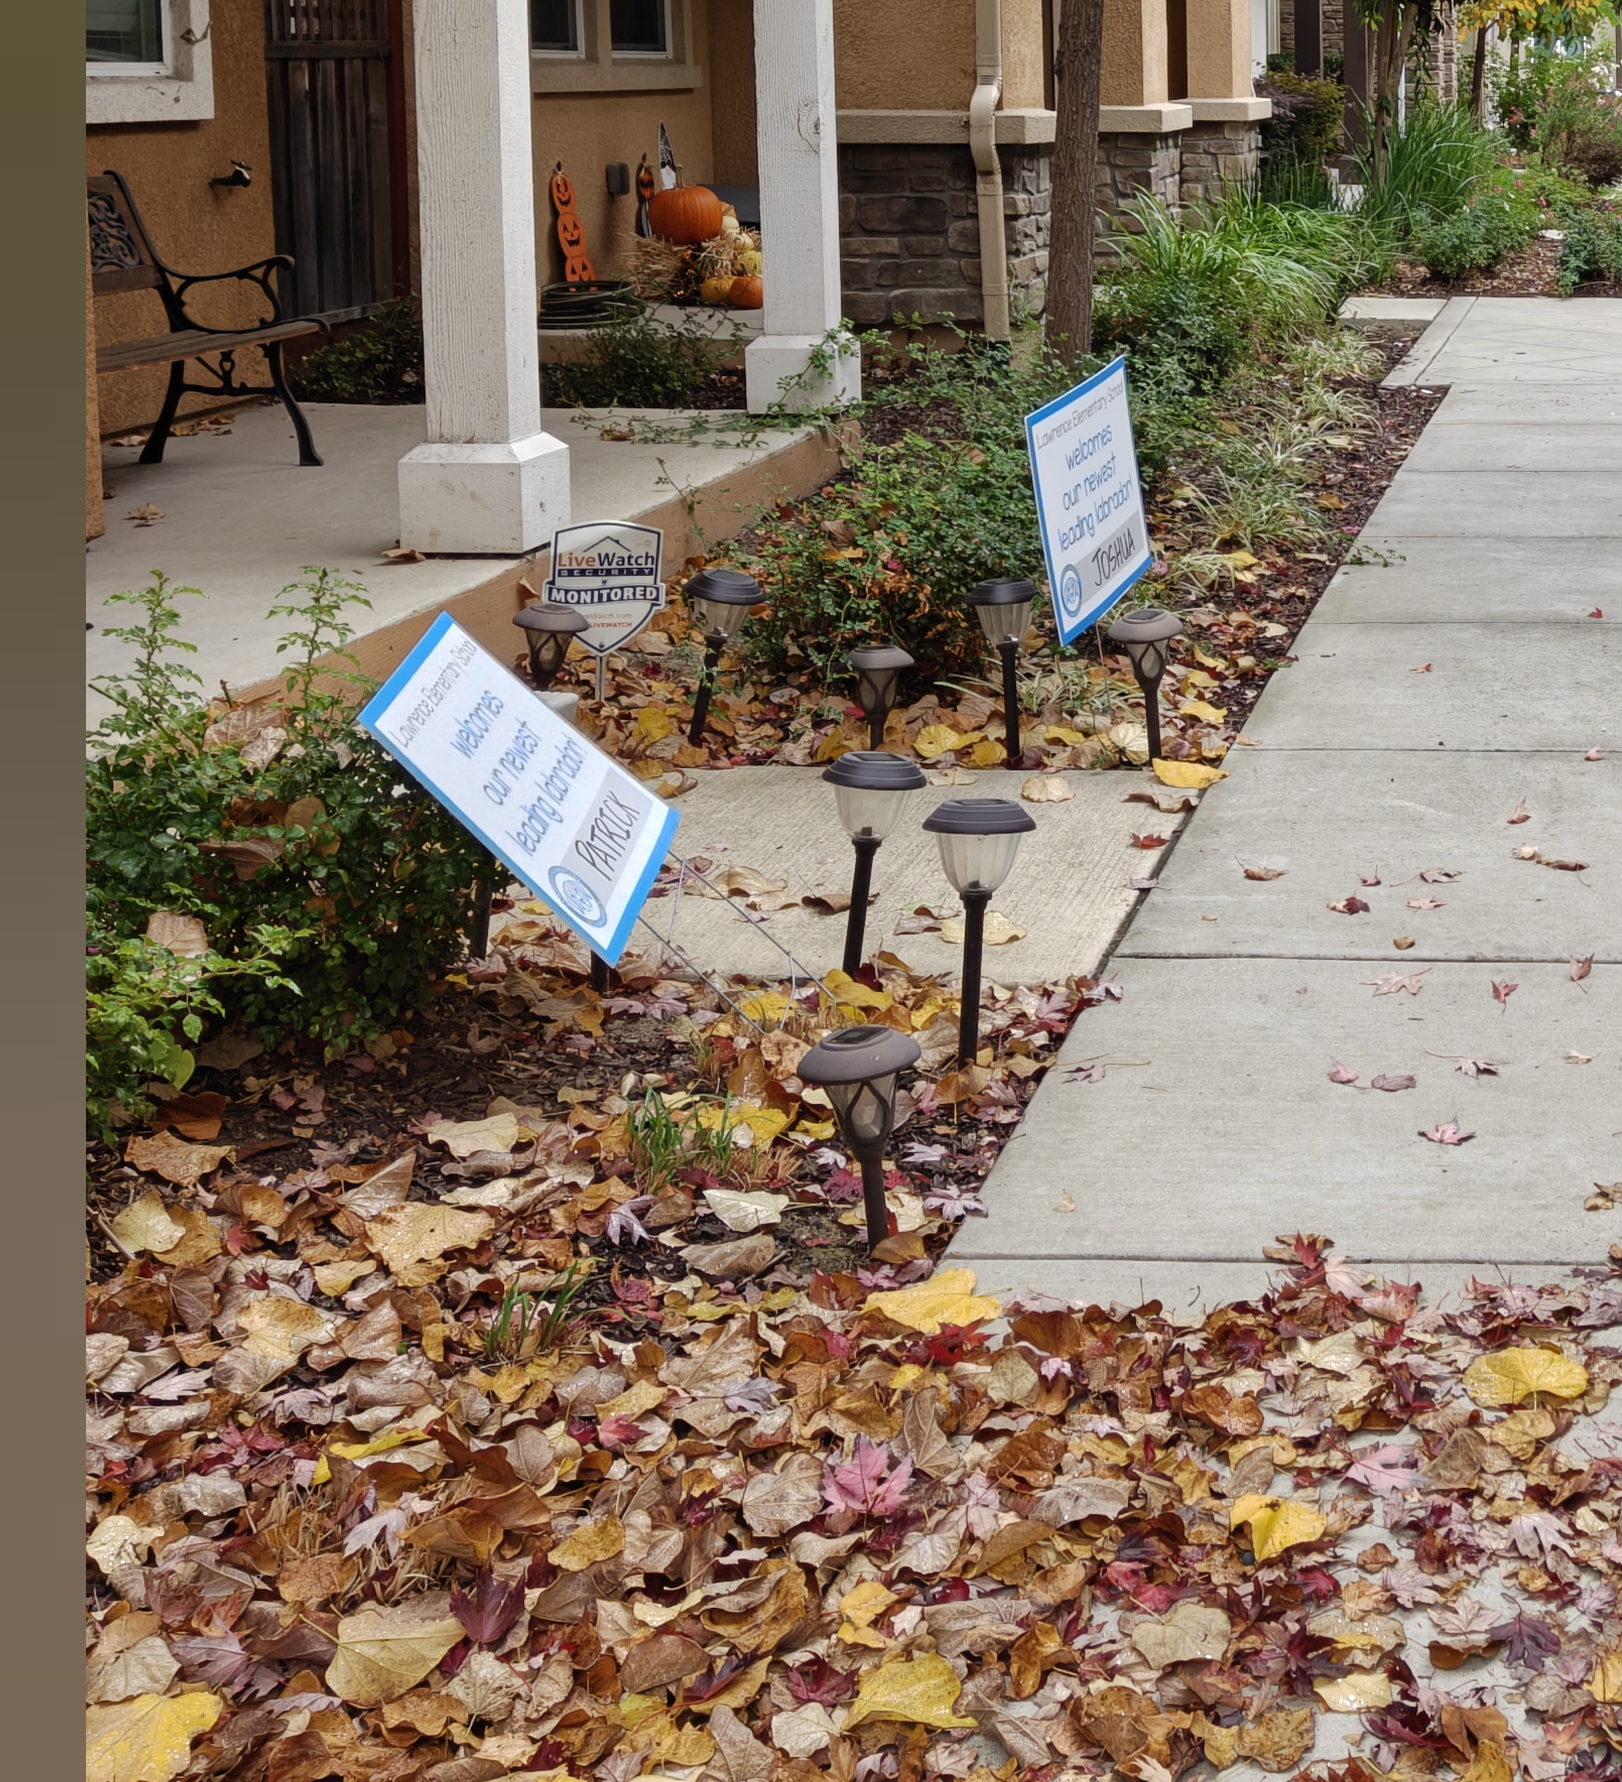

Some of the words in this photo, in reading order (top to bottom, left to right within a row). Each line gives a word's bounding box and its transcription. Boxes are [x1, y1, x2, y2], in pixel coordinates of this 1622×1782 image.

[1036, 418, 1073, 450] Lawrence
[1072, 396, 1108, 428] Elementary
[1107, 377, 1124, 403] School
[1065, 424, 1113, 472] welcomes
[1062, 482, 1082, 511] our
[1083, 450, 1117, 497] newest
[558, 551, 655, 567] LiveWatch
[1057, 512, 1095, 553] leading
[1091, 527, 1136, 587] JOSHUA
[550, 586, 658, 603] MONITORED
[560, 568, 653, 577] SECURITY
[388, 698, 435, 749] Lawrence
[421, 659, 468, 708] Elementary
[450, 635, 478, 666] School
[450, 689, 505, 760] welcomes
[482, 768, 513, 807] our
[498, 716, 543, 781] newest
[504, 793, 564, 858] leading
[574, 789, 641, 882] PATRICK
